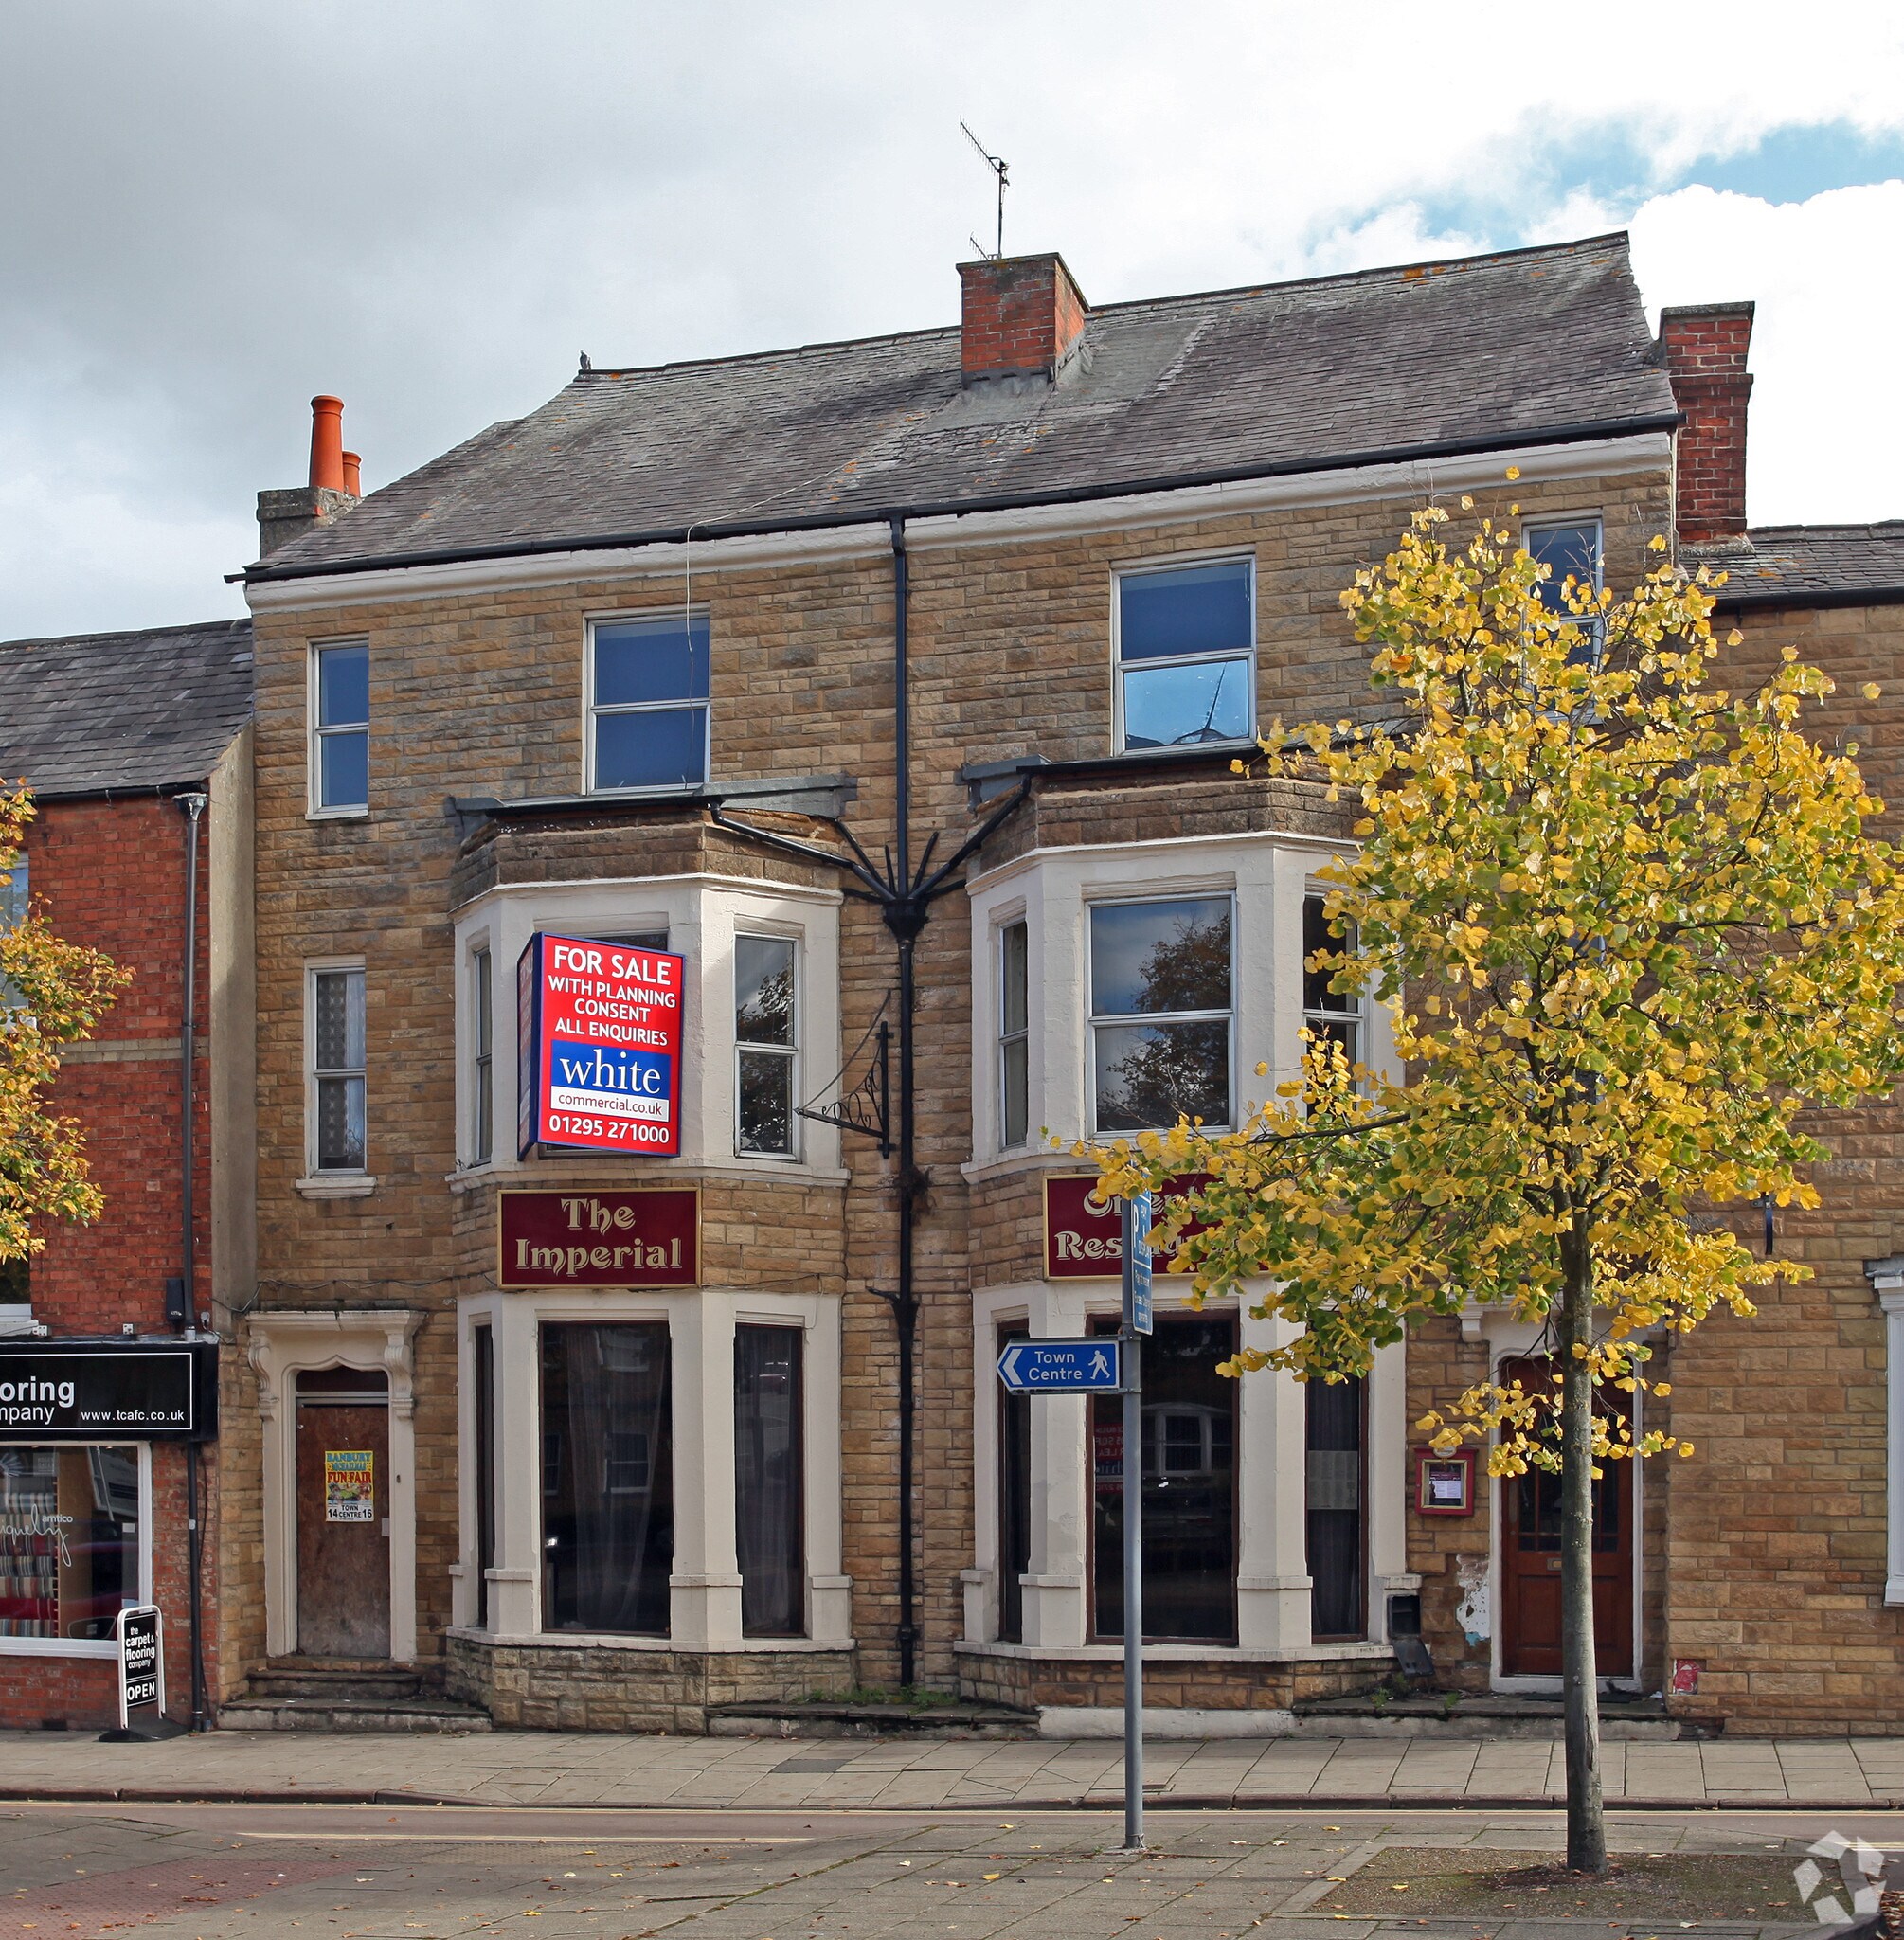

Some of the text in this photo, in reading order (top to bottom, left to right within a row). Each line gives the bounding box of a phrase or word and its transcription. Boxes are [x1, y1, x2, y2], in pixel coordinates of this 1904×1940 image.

[554, 945, 672, 985] FOR SALE
[548, 975, 676, 1008] WITH PLANNING
[574, 998, 651, 1023] CONSENT
[554, 1017, 668, 1046] ALL ENQUIRIES
[559, 1048, 661, 1094] white
[558, 1094, 662, 1116] commercial.co.uk
[549, 1115, 670, 1144] 01295 271000
[560, 1198, 636, 1236] The
[514, 1237, 683, 1278] Imperial
[1034, 1351, 1075, 1364] Town
[1028, 1367, 1083, 1381] Centre
[81, 1410, 185, 1421] www.tcafc.co.uk
[328, 1472, 371, 1483] FUN FAIR
[42, 1514, 73, 1523] amtico
[328, 1509, 338, 1518] 14
[362, 1509, 372, 1518] 16
[130, 1626, 138, 1636] the
[125, 1632, 154, 1648] carpet &
[125, 1646, 155, 1662] flooring
[128, 1659, 152, 1669] company
[127, 1681, 155, 1701] OPEN
